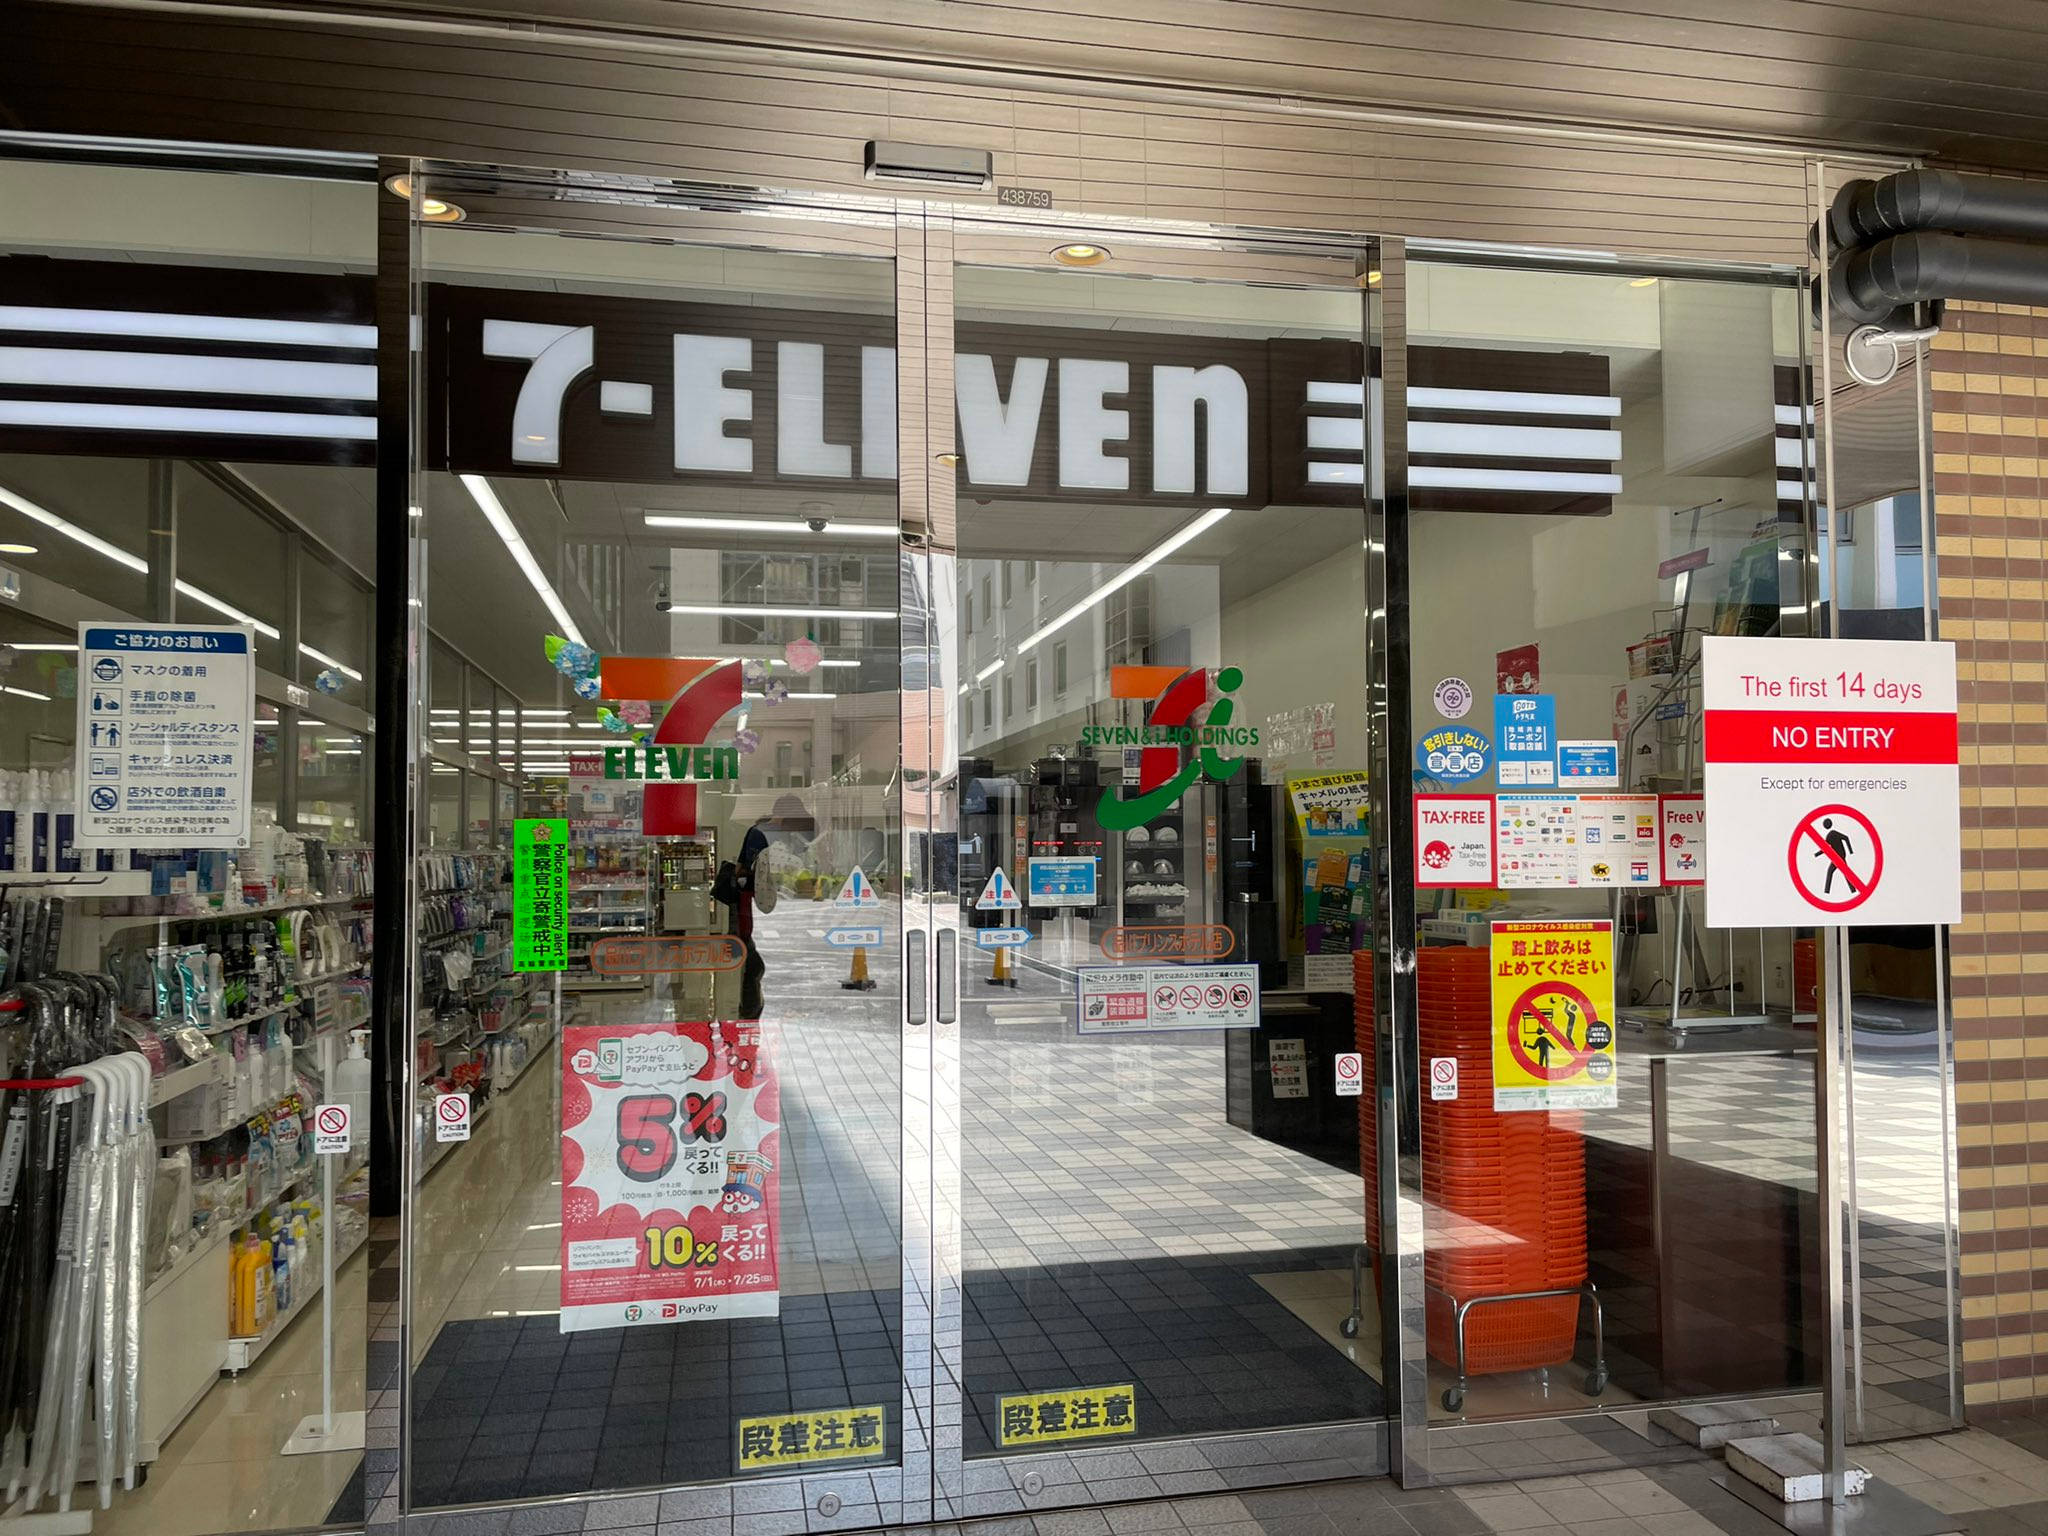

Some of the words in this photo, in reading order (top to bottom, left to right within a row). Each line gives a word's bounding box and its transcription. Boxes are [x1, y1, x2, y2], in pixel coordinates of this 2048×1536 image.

[1001, 190, 1048, 207] 438759
[114, 633, 219, 649] ご協力のお願い
[131, 665, 207, 677] マスクの着用
[1741, 676, 1782, 698] The
[1789, 676, 1828, 698] first
[1837, 671, 1866, 698] 14
[1874, 678, 1922, 704] days
[130, 690, 196, 703] 手指の除菌
[130, 722, 240, 733] ソーシャルディスタンス
[1165, 726, 1259, 746] HOLDINGS
[1508, 733, 1542, 742] クーポン
[1772, 726, 1808, 748] NO
[1816, 727, 1895, 748] ENTRY
[129, 754, 232, 766] キャッシュレス決済
[1430, 755, 1481, 770] 宣言店
[1761, 777, 1804, 791] Except
[1808, 777, 1825, 790] for
[1828, 778, 1907, 792] emergencies
[127, 786, 226, 798] 店外での飲酒自粛
[1422, 811, 1485, 824] TAX-FREE
[1667, 811, 1692, 824] Free
[554, 843, 566, 874] Police
[1459, 851, 1487, 859] Tax-free
[1468, 859, 1487, 868] Shop
[554, 876, 563, 888] on
[533, 844, 551, 957] 警察官立寄警戒中
[844, 889, 871, 898] 注意
[985, 890, 1012, 899] 注意
[552, 890, 566, 930] security
[554, 934, 565, 957] alert
[1511, 940, 1592, 956] 路上飲みは
[1498, 960, 1606, 977] 止めてください
[626, 1054, 665, 1063] アプリから
[625, 1061, 696, 1073] PayPayで支払うと
[684, 1146, 724, 1160] 戻って
[720, 1223, 768, 1242] 戻って
[644, 1225, 719, 1269] 10%
[678, 1302, 718, 1315] PayPay
[1004, 1392, 1134, 1438] 段差注意
[742, 1413, 882, 1460] 段差注意
